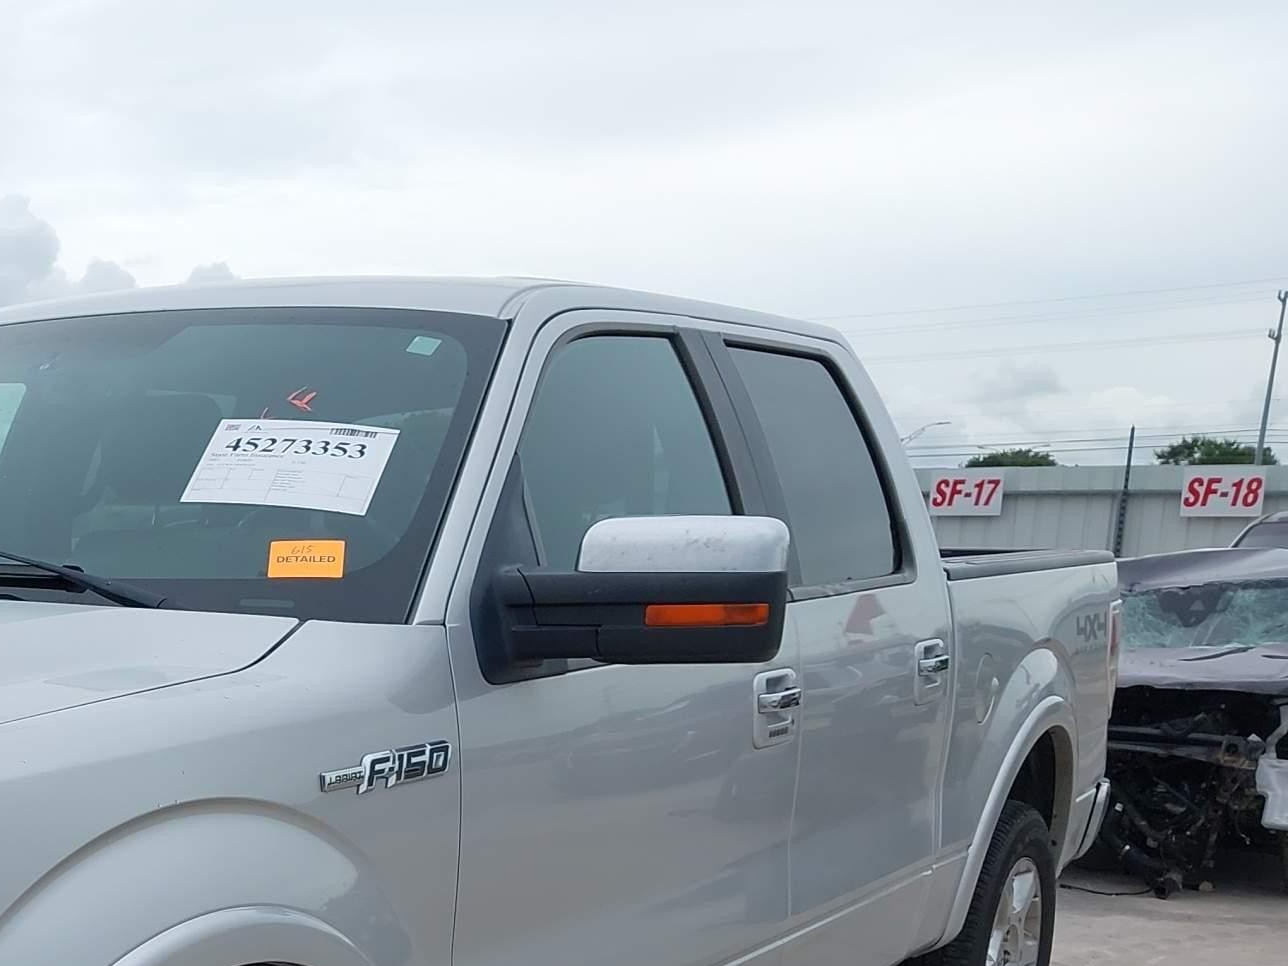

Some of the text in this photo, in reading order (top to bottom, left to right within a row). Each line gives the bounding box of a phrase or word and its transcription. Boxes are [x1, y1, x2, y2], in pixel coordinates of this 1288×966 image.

[225, 437, 367, 459] 45273353
[931, 479, 1001, 507] SF-17
[1183, 477, 1263, 508] SF-18
[276, 555, 336, 563] DETAILED
